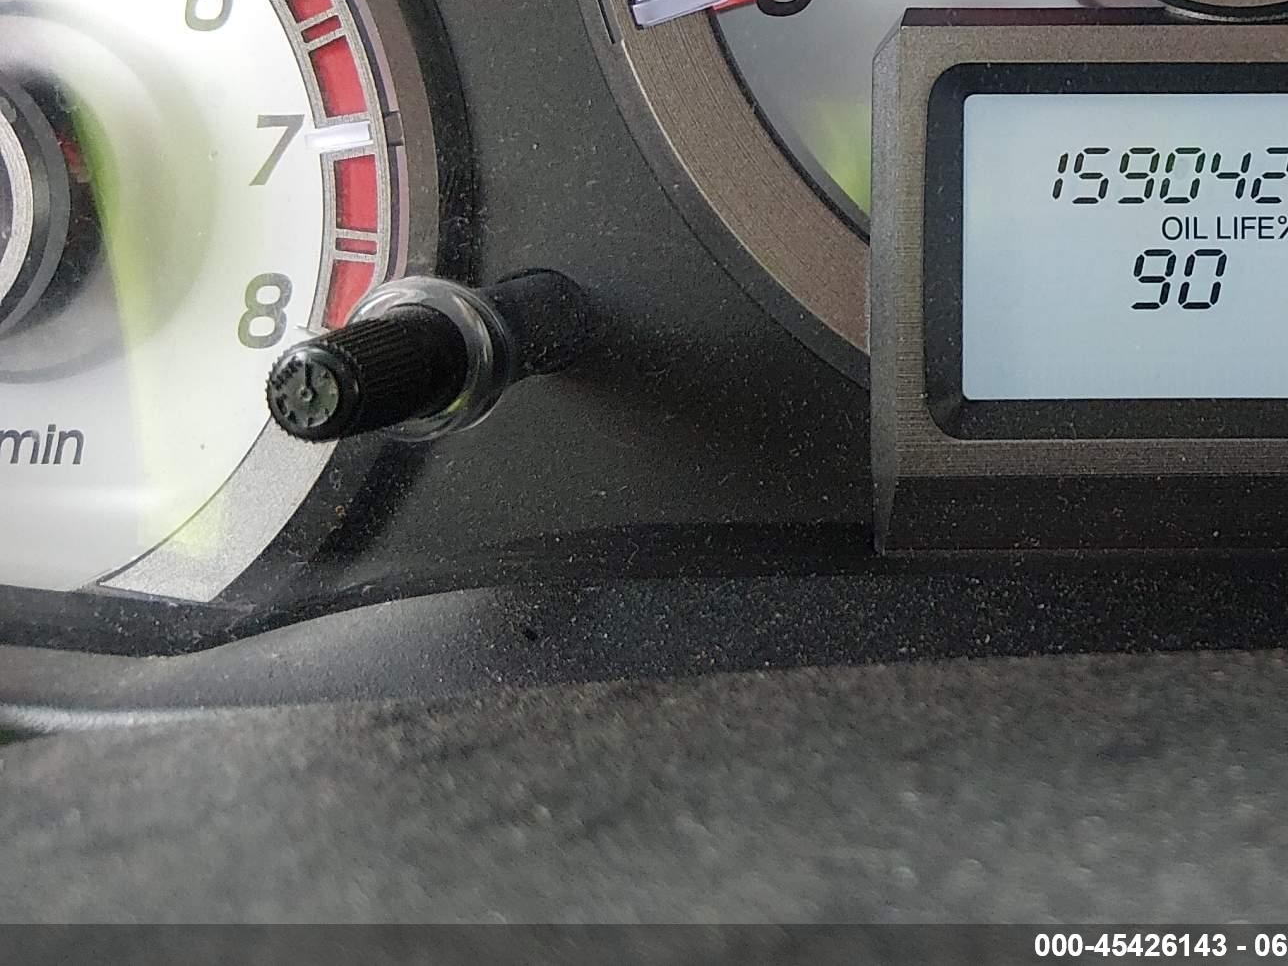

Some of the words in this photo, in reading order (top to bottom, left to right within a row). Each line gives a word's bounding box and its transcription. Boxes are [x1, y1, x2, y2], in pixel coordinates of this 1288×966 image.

[249, 114, 304, 186] 7
[1162, 217, 1208, 240] OIL
[237, 273, 294, 349] 8
[1132, 249, 1227, 309] 90
